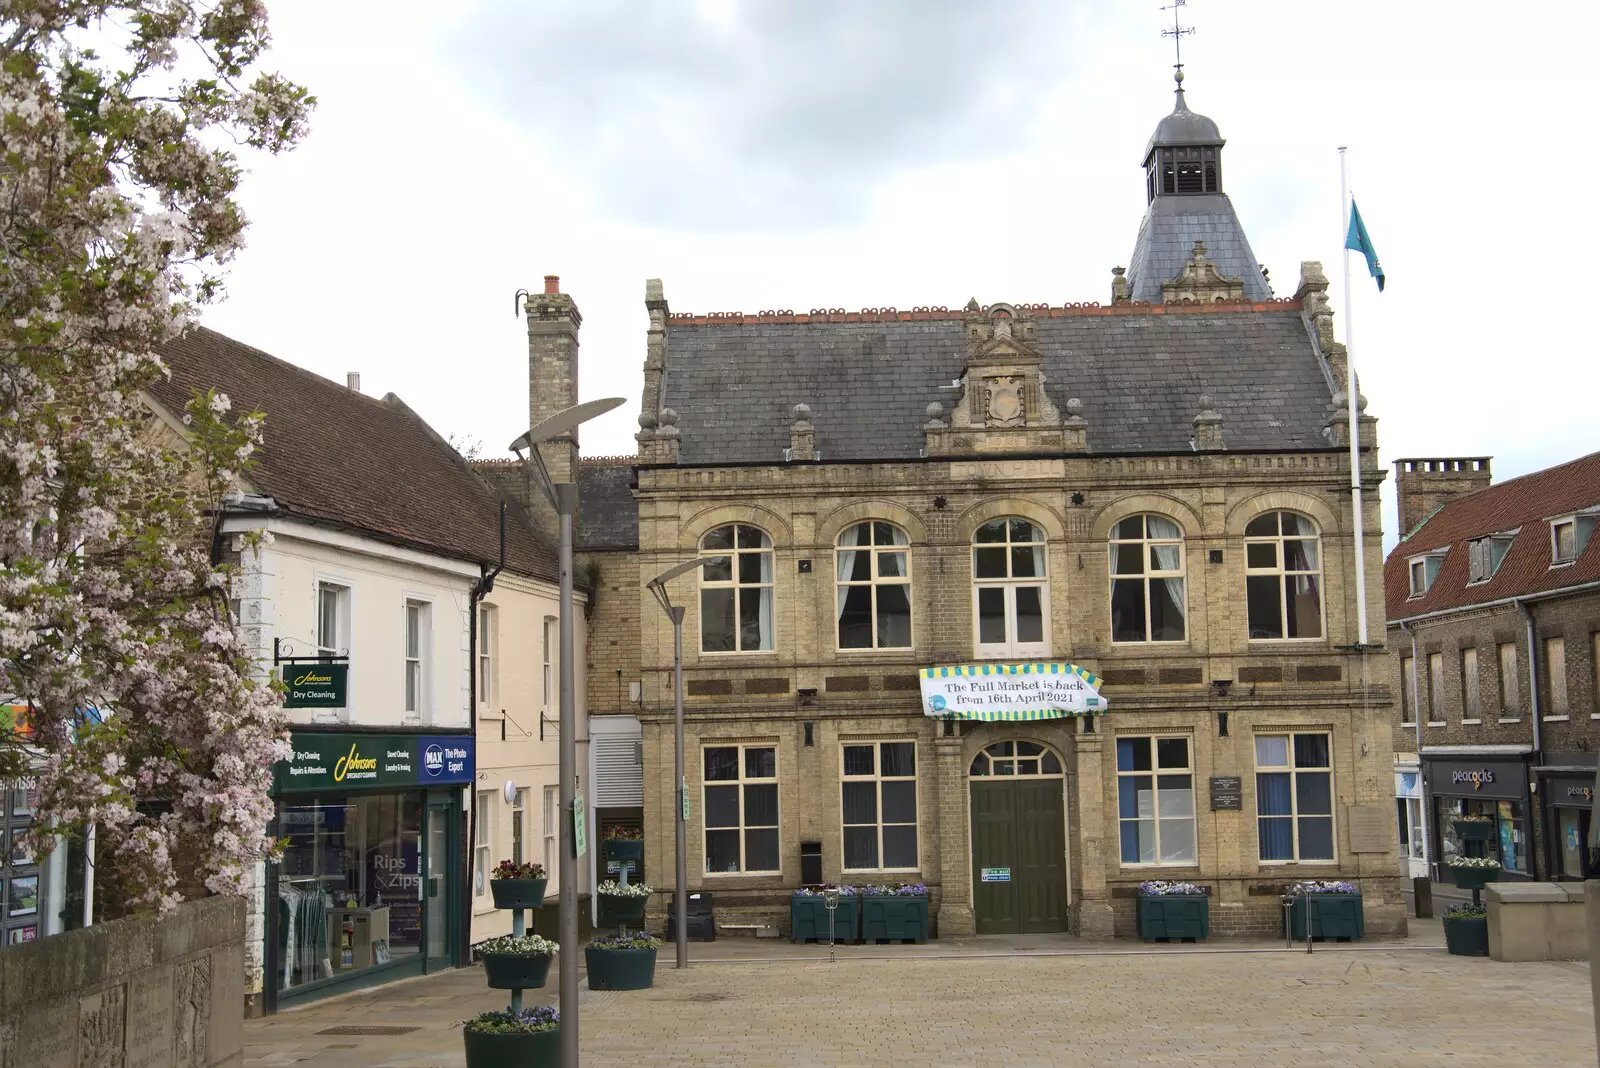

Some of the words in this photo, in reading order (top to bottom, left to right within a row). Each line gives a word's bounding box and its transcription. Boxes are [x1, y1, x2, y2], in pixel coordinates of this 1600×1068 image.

[954, 462, 1005, 477] TOWN
[1013, 461, 1060, 475] HALL
[294, 671, 332, 686] Johnsons
[945, 683, 967, 693] The
[970, 682, 994, 692] Full
[997, 681, 1039, 691] Market
[1043, 680, 1053, 689] is
[1056, 680, 1083, 690] back
[293, 691, 306, 699] Dry
[307, 691, 336, 699] Cleaning
[956, 694, 983, 704] from
[988, 693, 1012, 703] 16th
[1016, 692, 1045, 704] April
[1047, 693, 1074, 703] 2021
[297, 752, 305, 760] Dry
[305, 752, 320, 760] Cleaning
[397, 751, 409, 759] Cleaning
[426, 752, 443, 764] MAX
[445, 749, 453, 758] The
[454, 749, 467, 758] Photo
[334, 743, 377, 782] Johnsons
[385, 764, 397, 772] Laundry
[448, 761, 463, 773] Expert
[290, 767, 304, 776] Repairs
[308, 766, 327, 774] Alterations
[1452, 769, 1493, 786] peacocks
[374, 855, 406, 871] Rips
[374, 870, 389, 889] &
[389, 873, 420, 889] Zips
